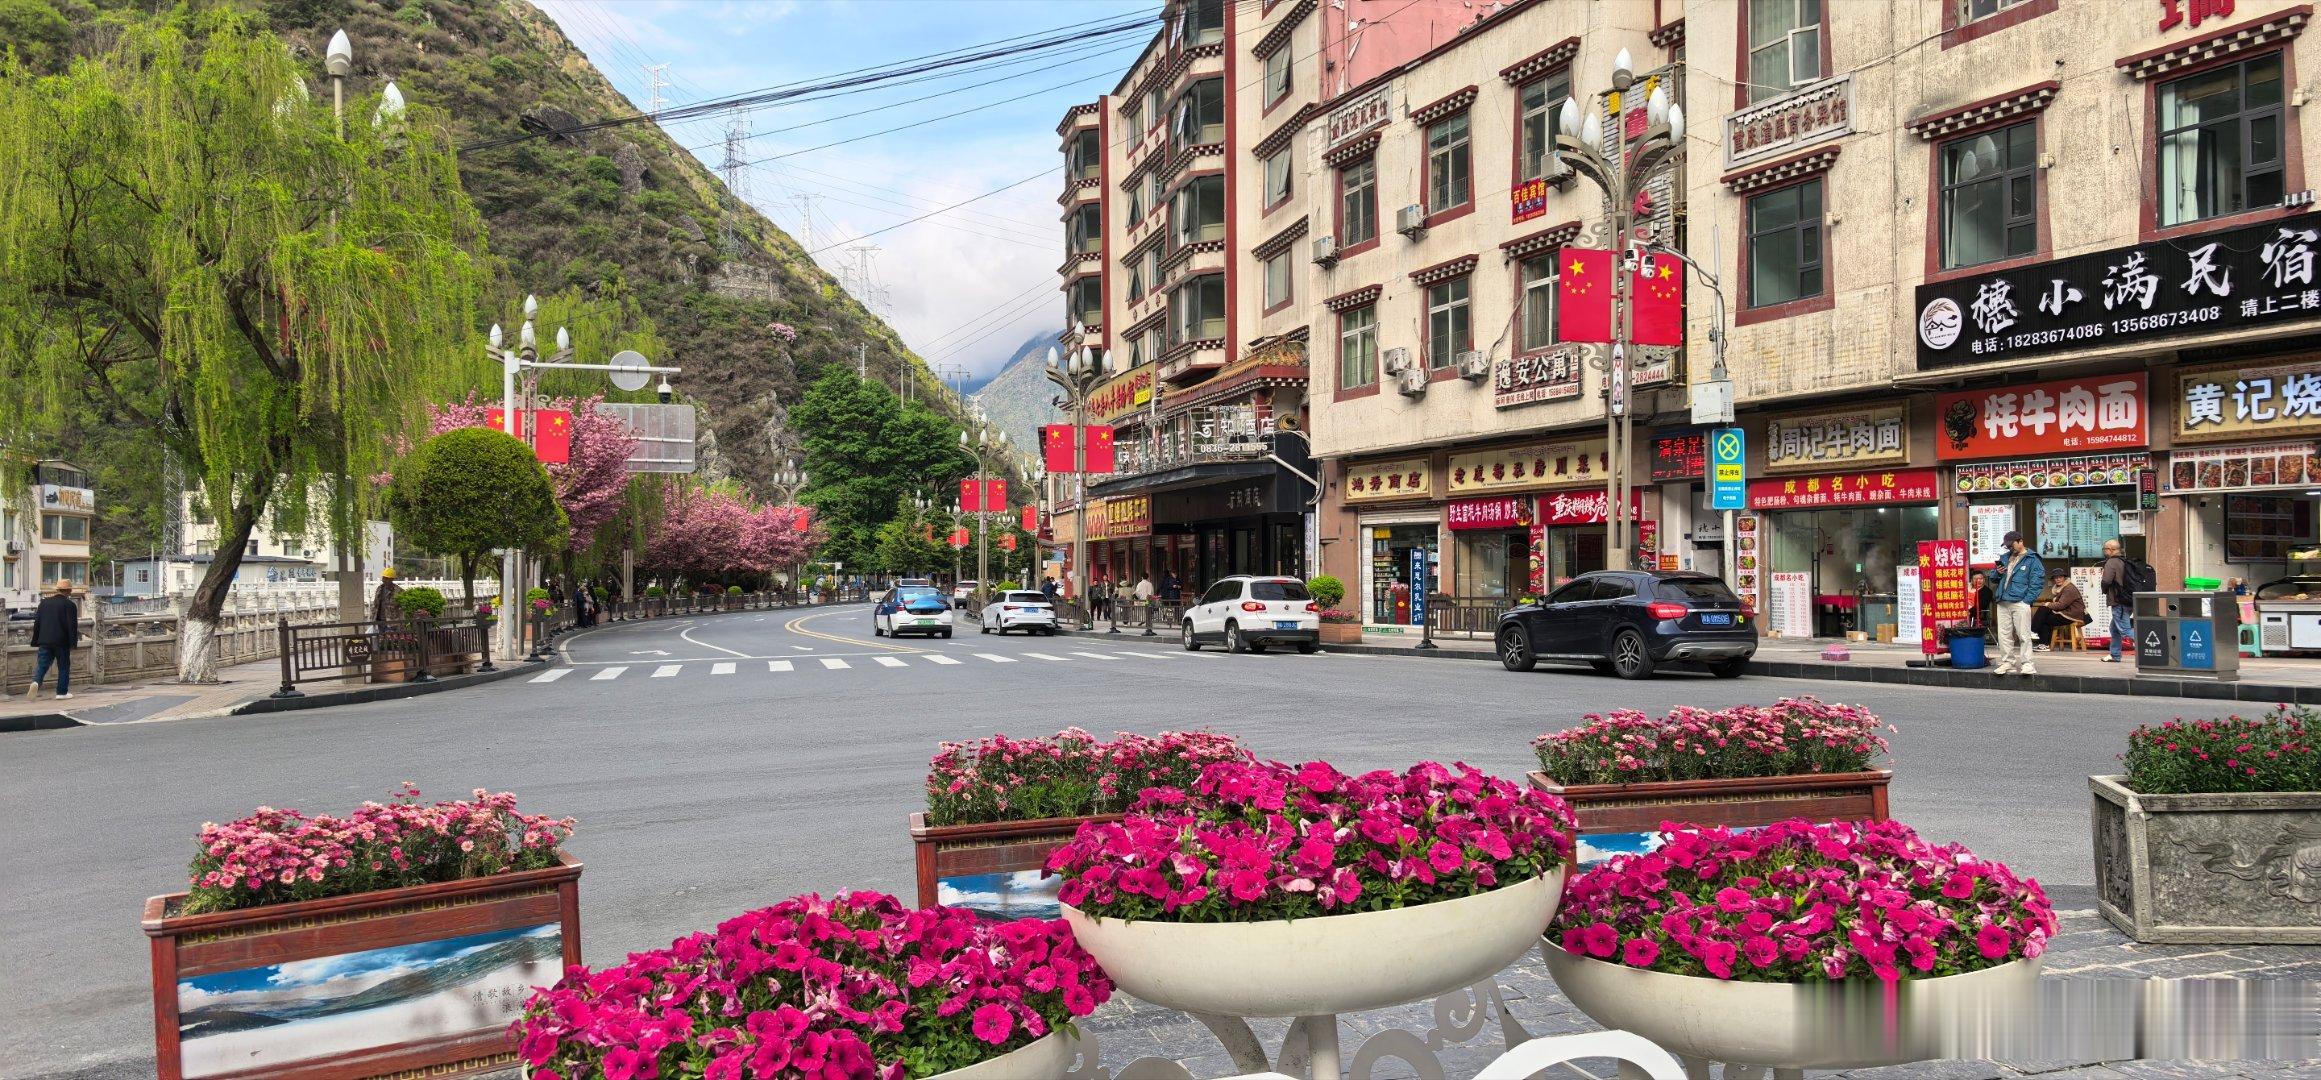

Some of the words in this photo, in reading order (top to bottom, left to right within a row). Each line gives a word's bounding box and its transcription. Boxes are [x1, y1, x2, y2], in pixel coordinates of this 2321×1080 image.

[1970, 228, 2318, 334] 穗小满民宿
[2112, 306, 2220, 341] 13568673408
[2240, 290, 2321, 318] 请上二楼
[1498, 349, 1567, 389] 逸安公寓
[1985, 380, 2138, 440] 牦牛肉面
[2186, 373, 2321, 427] 黄记烧
[1780, 418, 1903, 459] 周记牛肉面
[2086, 433, 2137, 445] 15984744812
[1785, 473, 1895, 494] 成都名小吃
[1934, 542, 1964, 567] 烧烤
[1919, 554, 1933, 640] 欢迎光临
